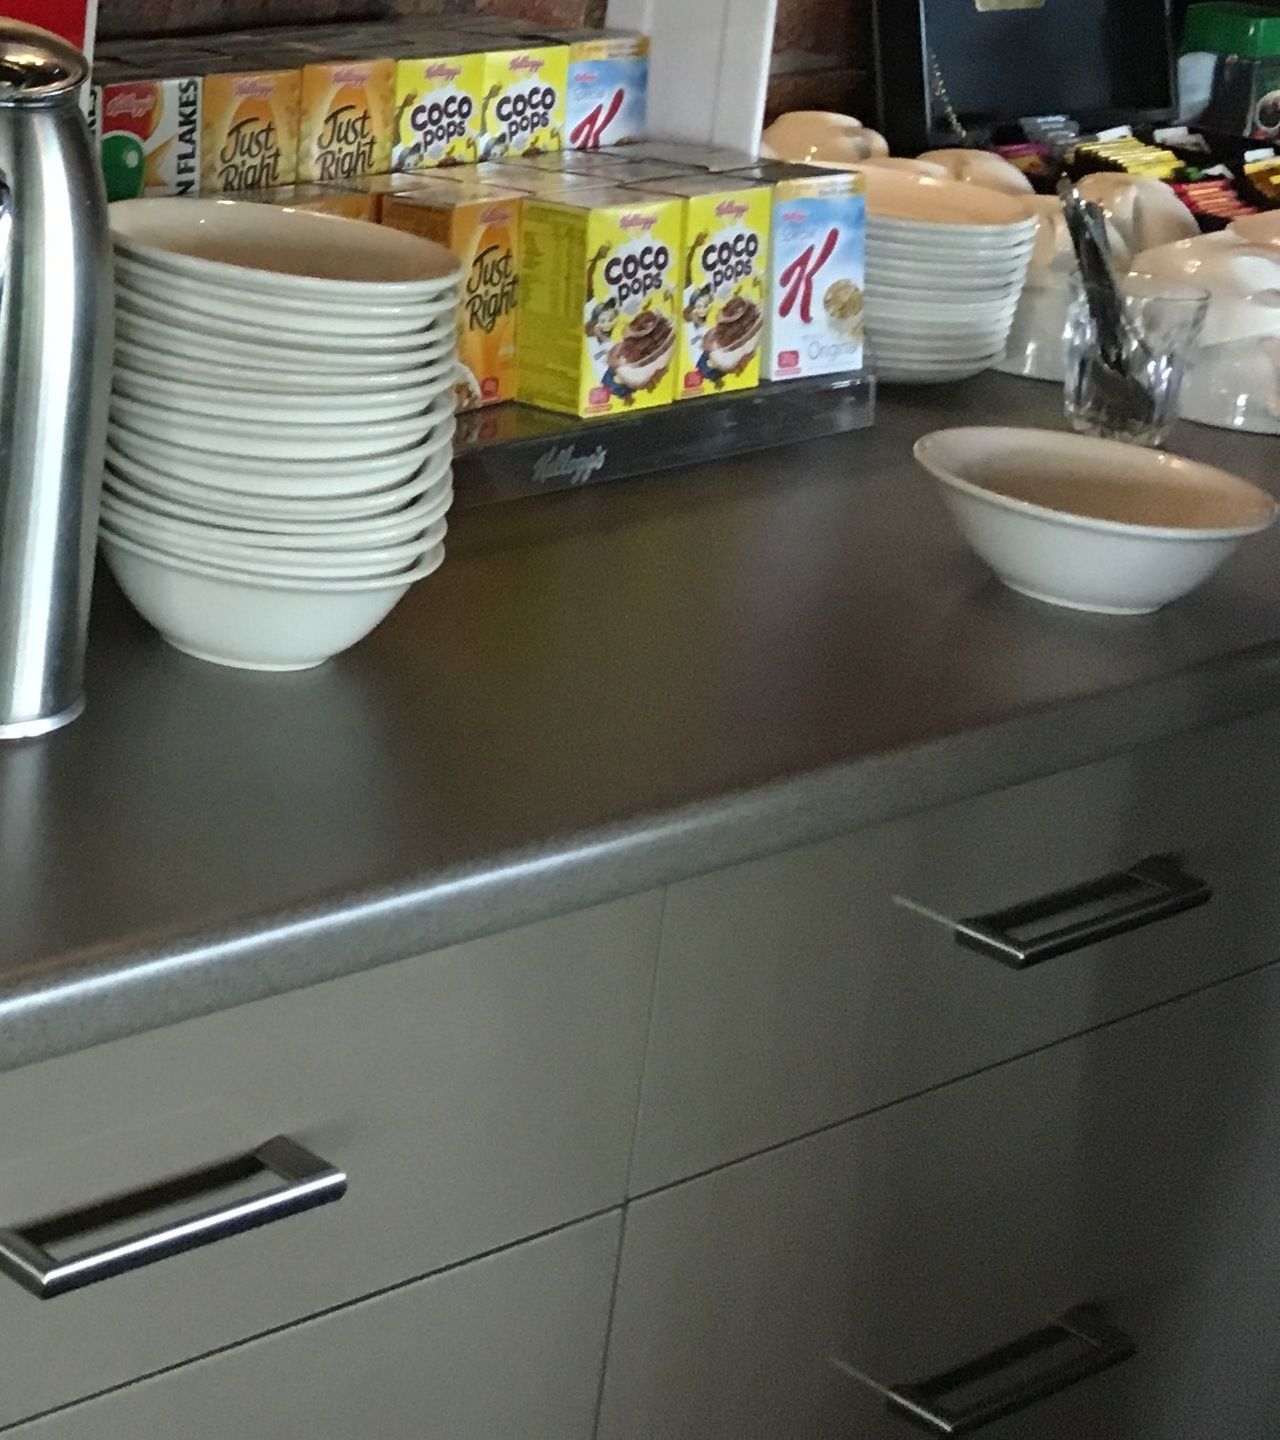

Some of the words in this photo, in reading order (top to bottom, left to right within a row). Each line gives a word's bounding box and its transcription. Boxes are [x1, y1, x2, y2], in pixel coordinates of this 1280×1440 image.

[176, 79, 199, 176] FLAKES
[220, 116, 276, 164] Just
[317, 104, 371, 150] Just
[218, 149, 281, 193] Right
[315, 135, 378, 182] Right
[466, 244, 513, 294] Just
[778, 227, 840, 324] K
[465, 274, 519, 334] Right
